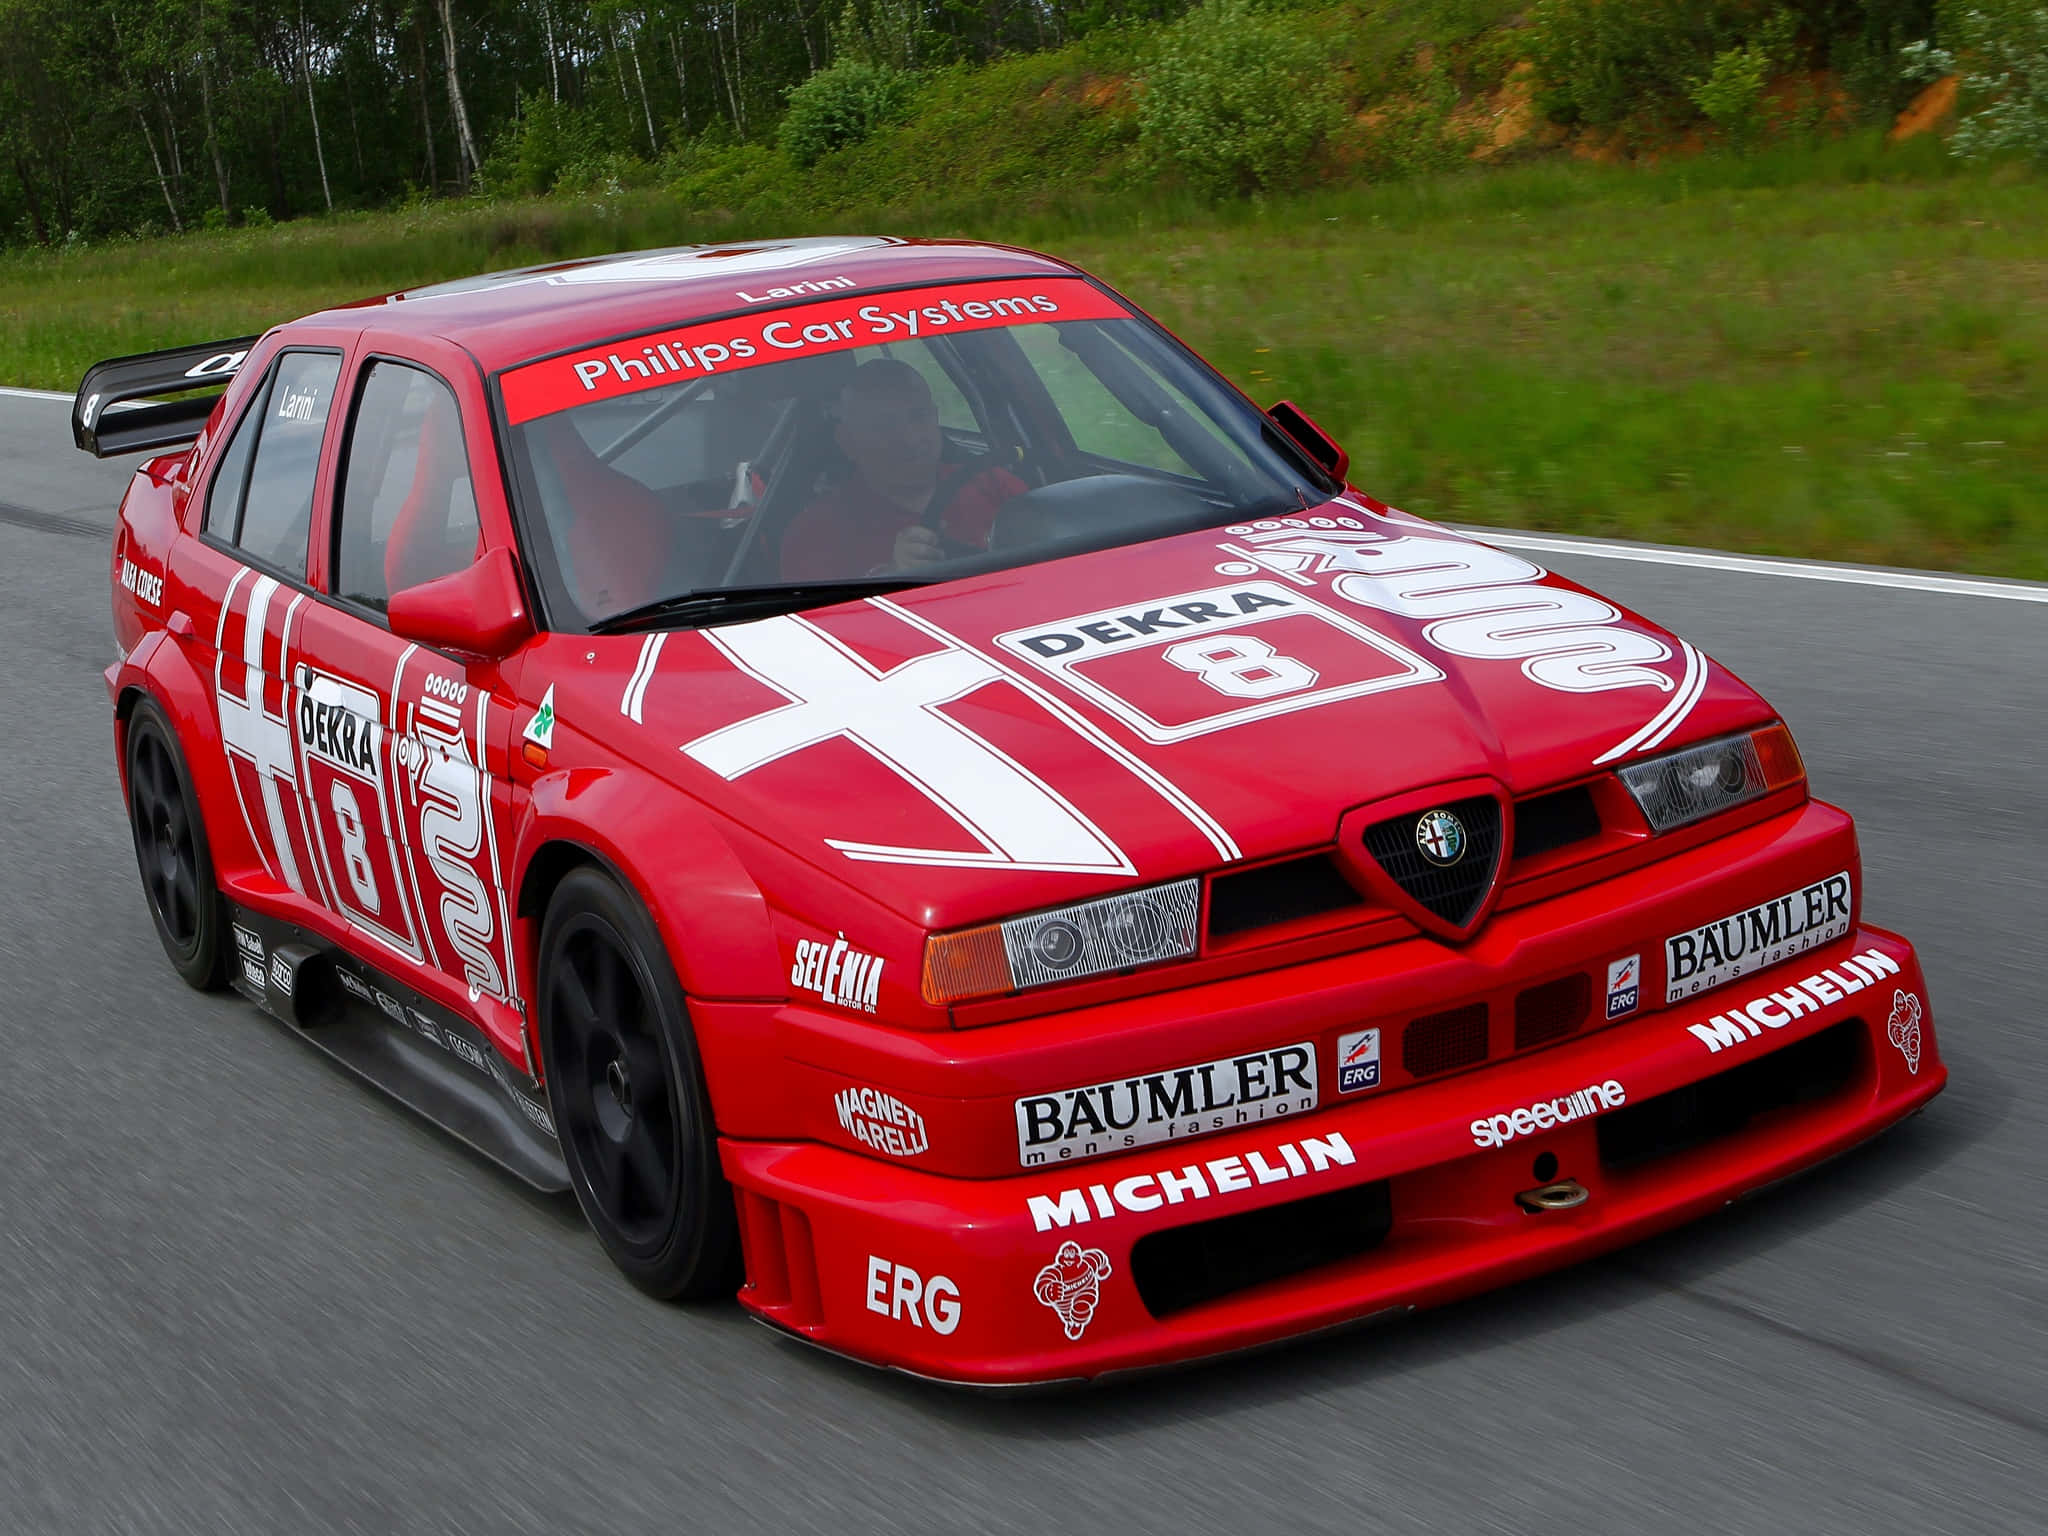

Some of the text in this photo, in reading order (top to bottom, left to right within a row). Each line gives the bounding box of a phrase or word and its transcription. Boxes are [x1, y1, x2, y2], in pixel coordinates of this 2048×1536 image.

[736, 275, 857, 304] Larini
[573, 293, 1058, 391] Philips Car Systems
[83, 394, 100, 428] 8
[279, 385, 318, 420] Larini
[121, 558, 163, 607] ALFA CORSE
[1019, 592, 1296, 658] DEKRA
[1161, 634, 1321, 699] 8
[301, 695, 377, 776] DEKRA
[331, 778, 380, 916] 8
[1669, 875, 1848, 982] BÄUMLER
[1671, 922, 1847, 1001] men's fashion
[791, 930, 885, 1005] SELÈNIA
[1686, 949, 1900, 1053] MICHELIN
[837, 997, 876, 1014] MOTOR OIL
[1610, 994, 1636, 1011] ERG
[1021, 1046, 1312, 1146] BÄUMLER
[1343, 1065, 1375, 1085] ERG
[834, 1087, 928, 1140] MAGNETI
[838, 1110, 929, 1156] MARELLI
[1026, 1096, 1312, 1164] men's fashion
[1026, 1132, 1356, 1232] MICHELIN
[866, 1254, 962, 1335] ERG
